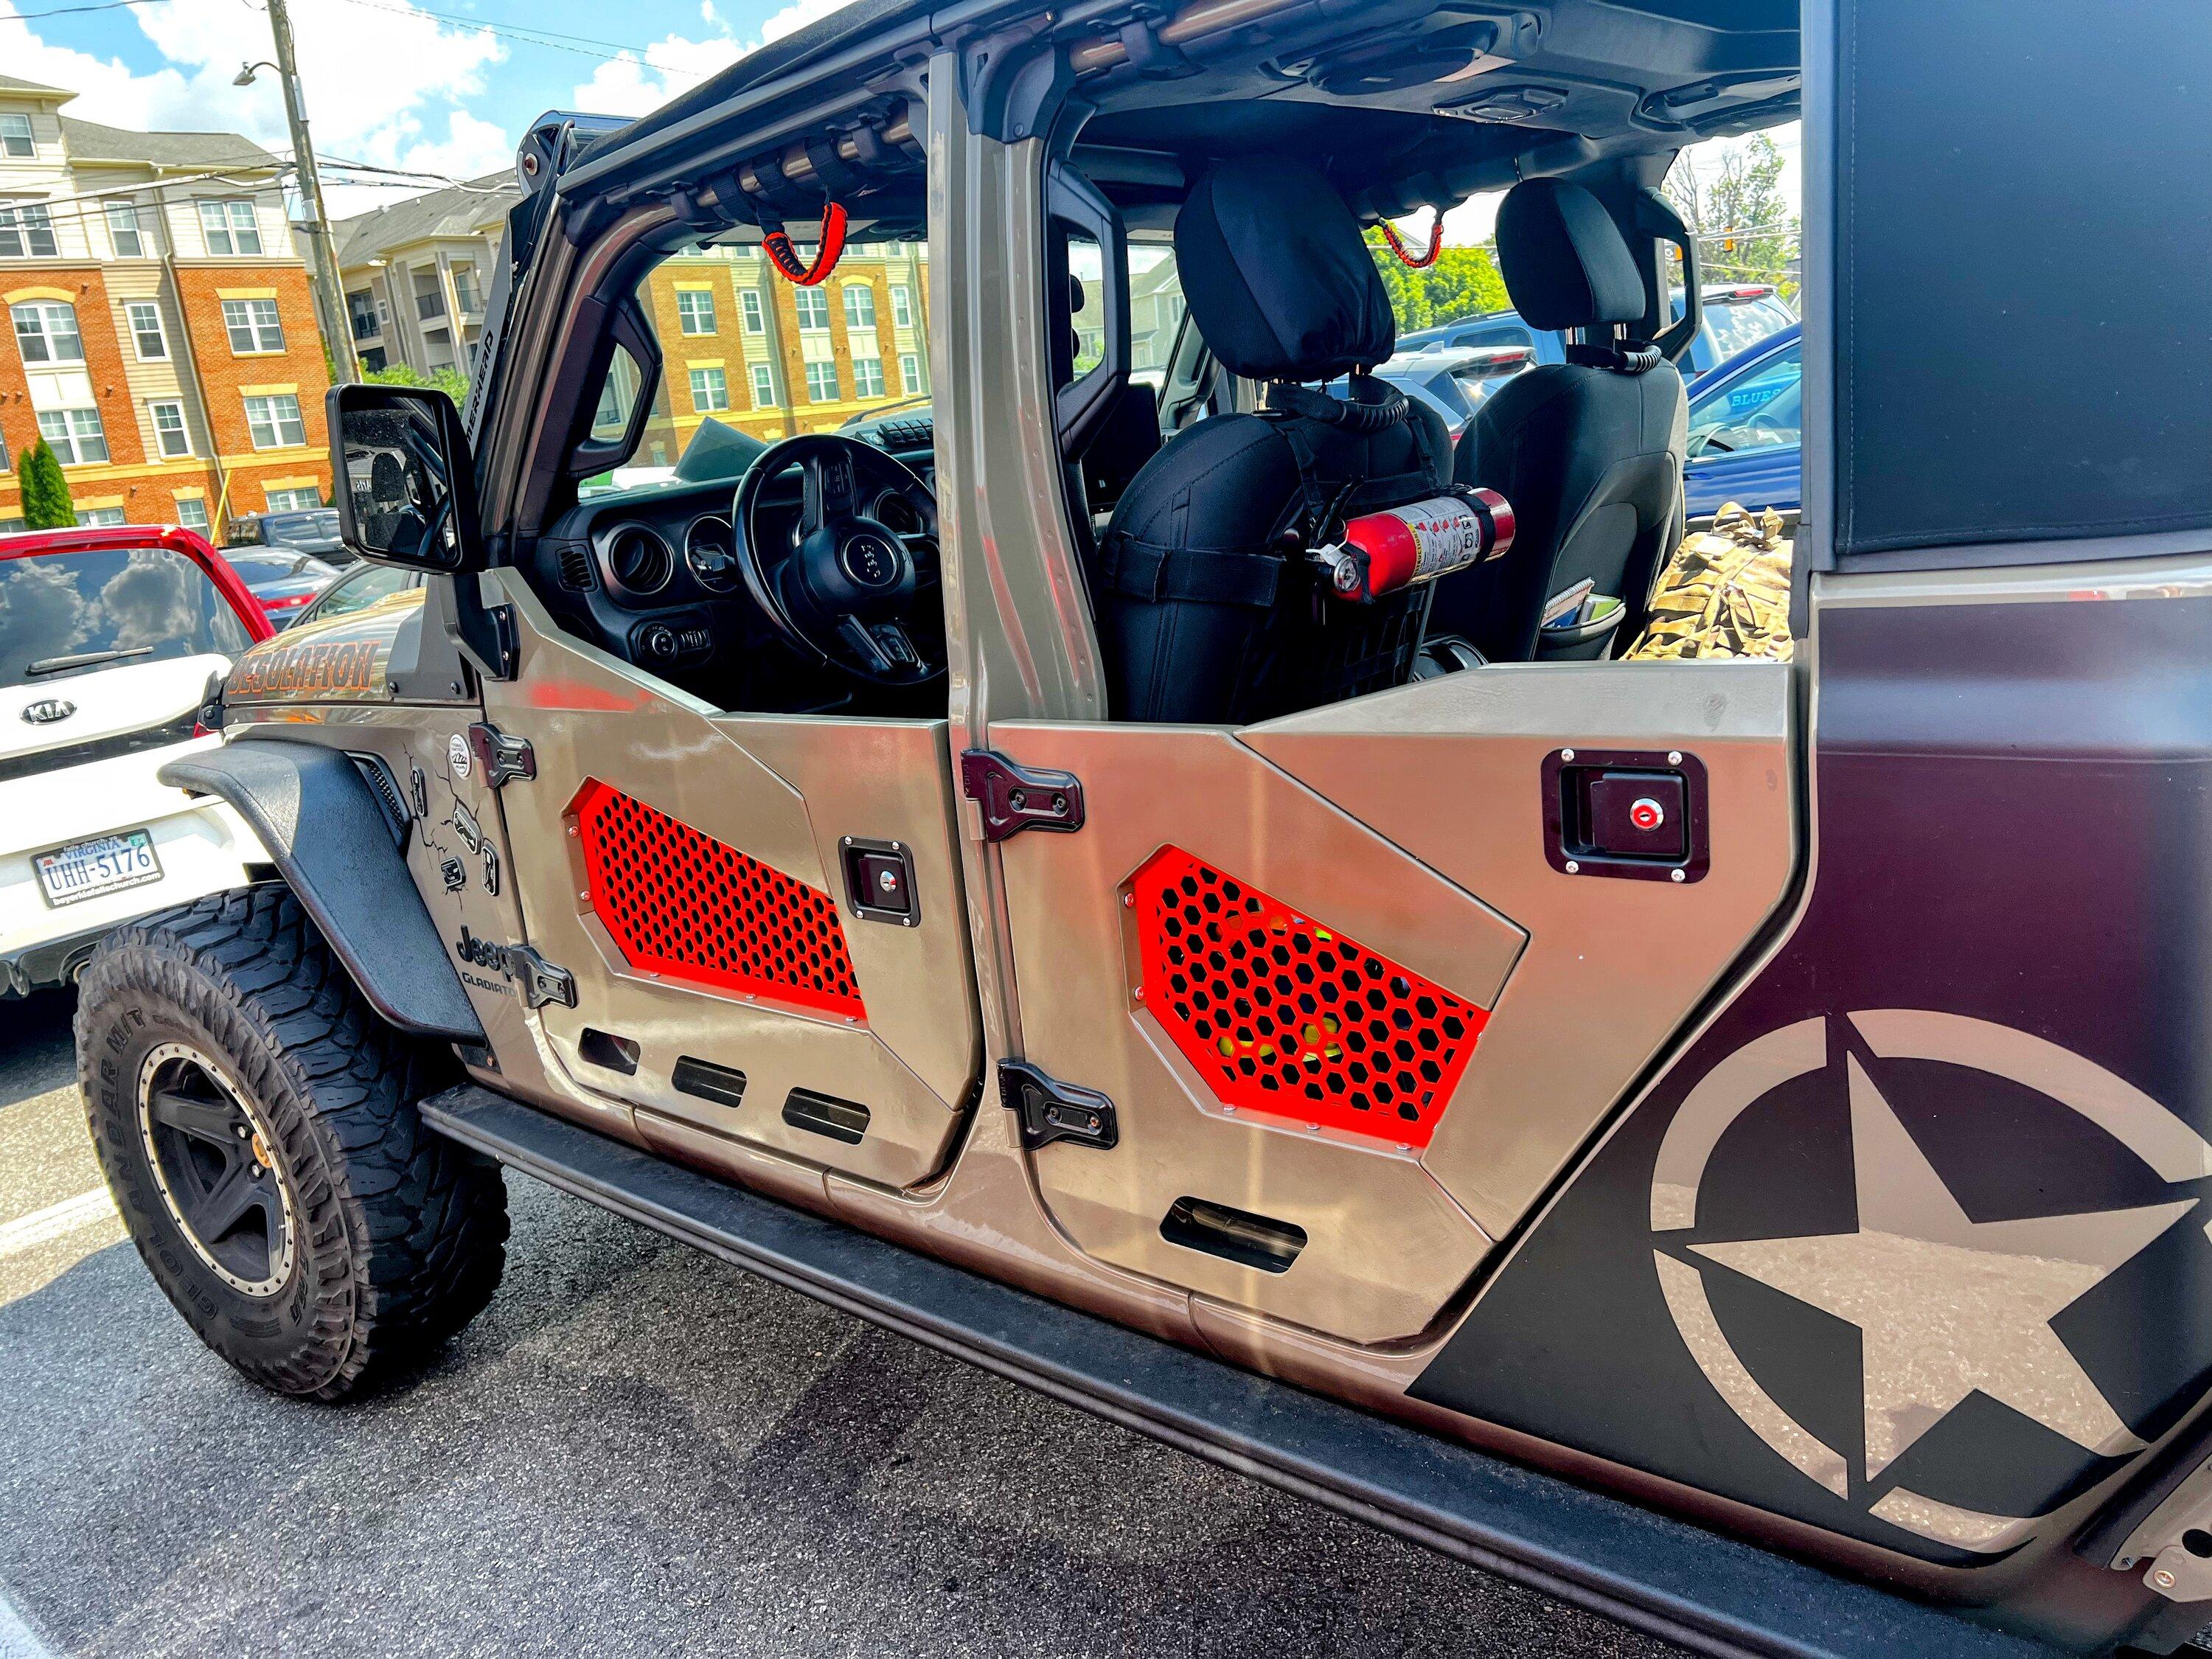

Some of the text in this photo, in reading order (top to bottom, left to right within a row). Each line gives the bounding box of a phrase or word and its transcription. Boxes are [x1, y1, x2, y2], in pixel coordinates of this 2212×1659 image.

[227, 640, 383, 695] DESOLATION
[27, 700, 72, 722] KIA
[45, 844, 150, 890] UHH-5176
[64, 841, 121, 860] VIRGINIA
[456, 925, 513, 983] Jeep
